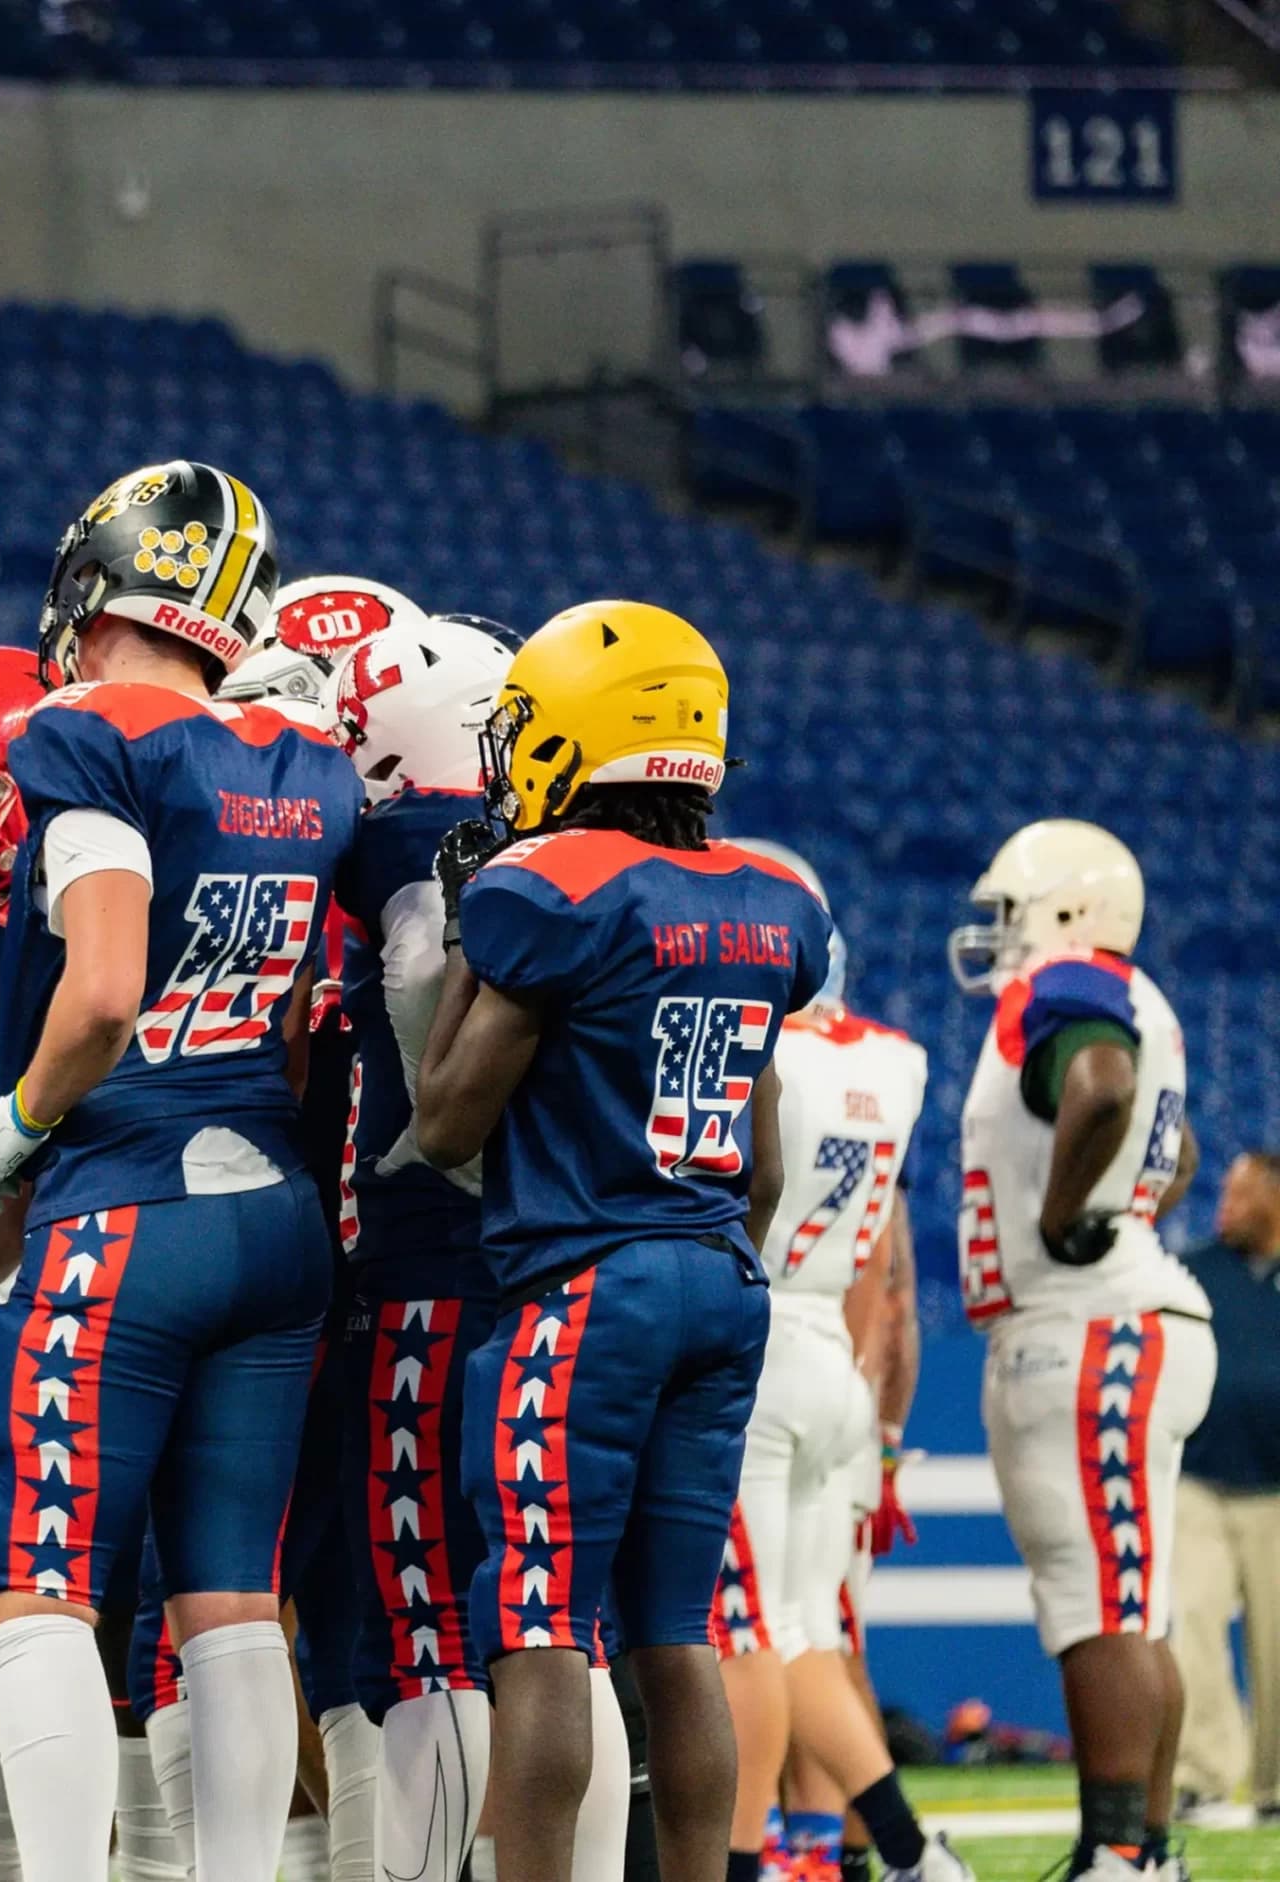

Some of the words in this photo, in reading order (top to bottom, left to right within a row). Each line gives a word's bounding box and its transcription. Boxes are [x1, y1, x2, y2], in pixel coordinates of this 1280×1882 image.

[1039, 116, 1170, 187] 121
[153, 603, 242, 660] Riddell
[645, 756, 724, 787] Riddell
[653, 922, 709, 968] HOT
[718, 921, 792, 969] SAUCE
